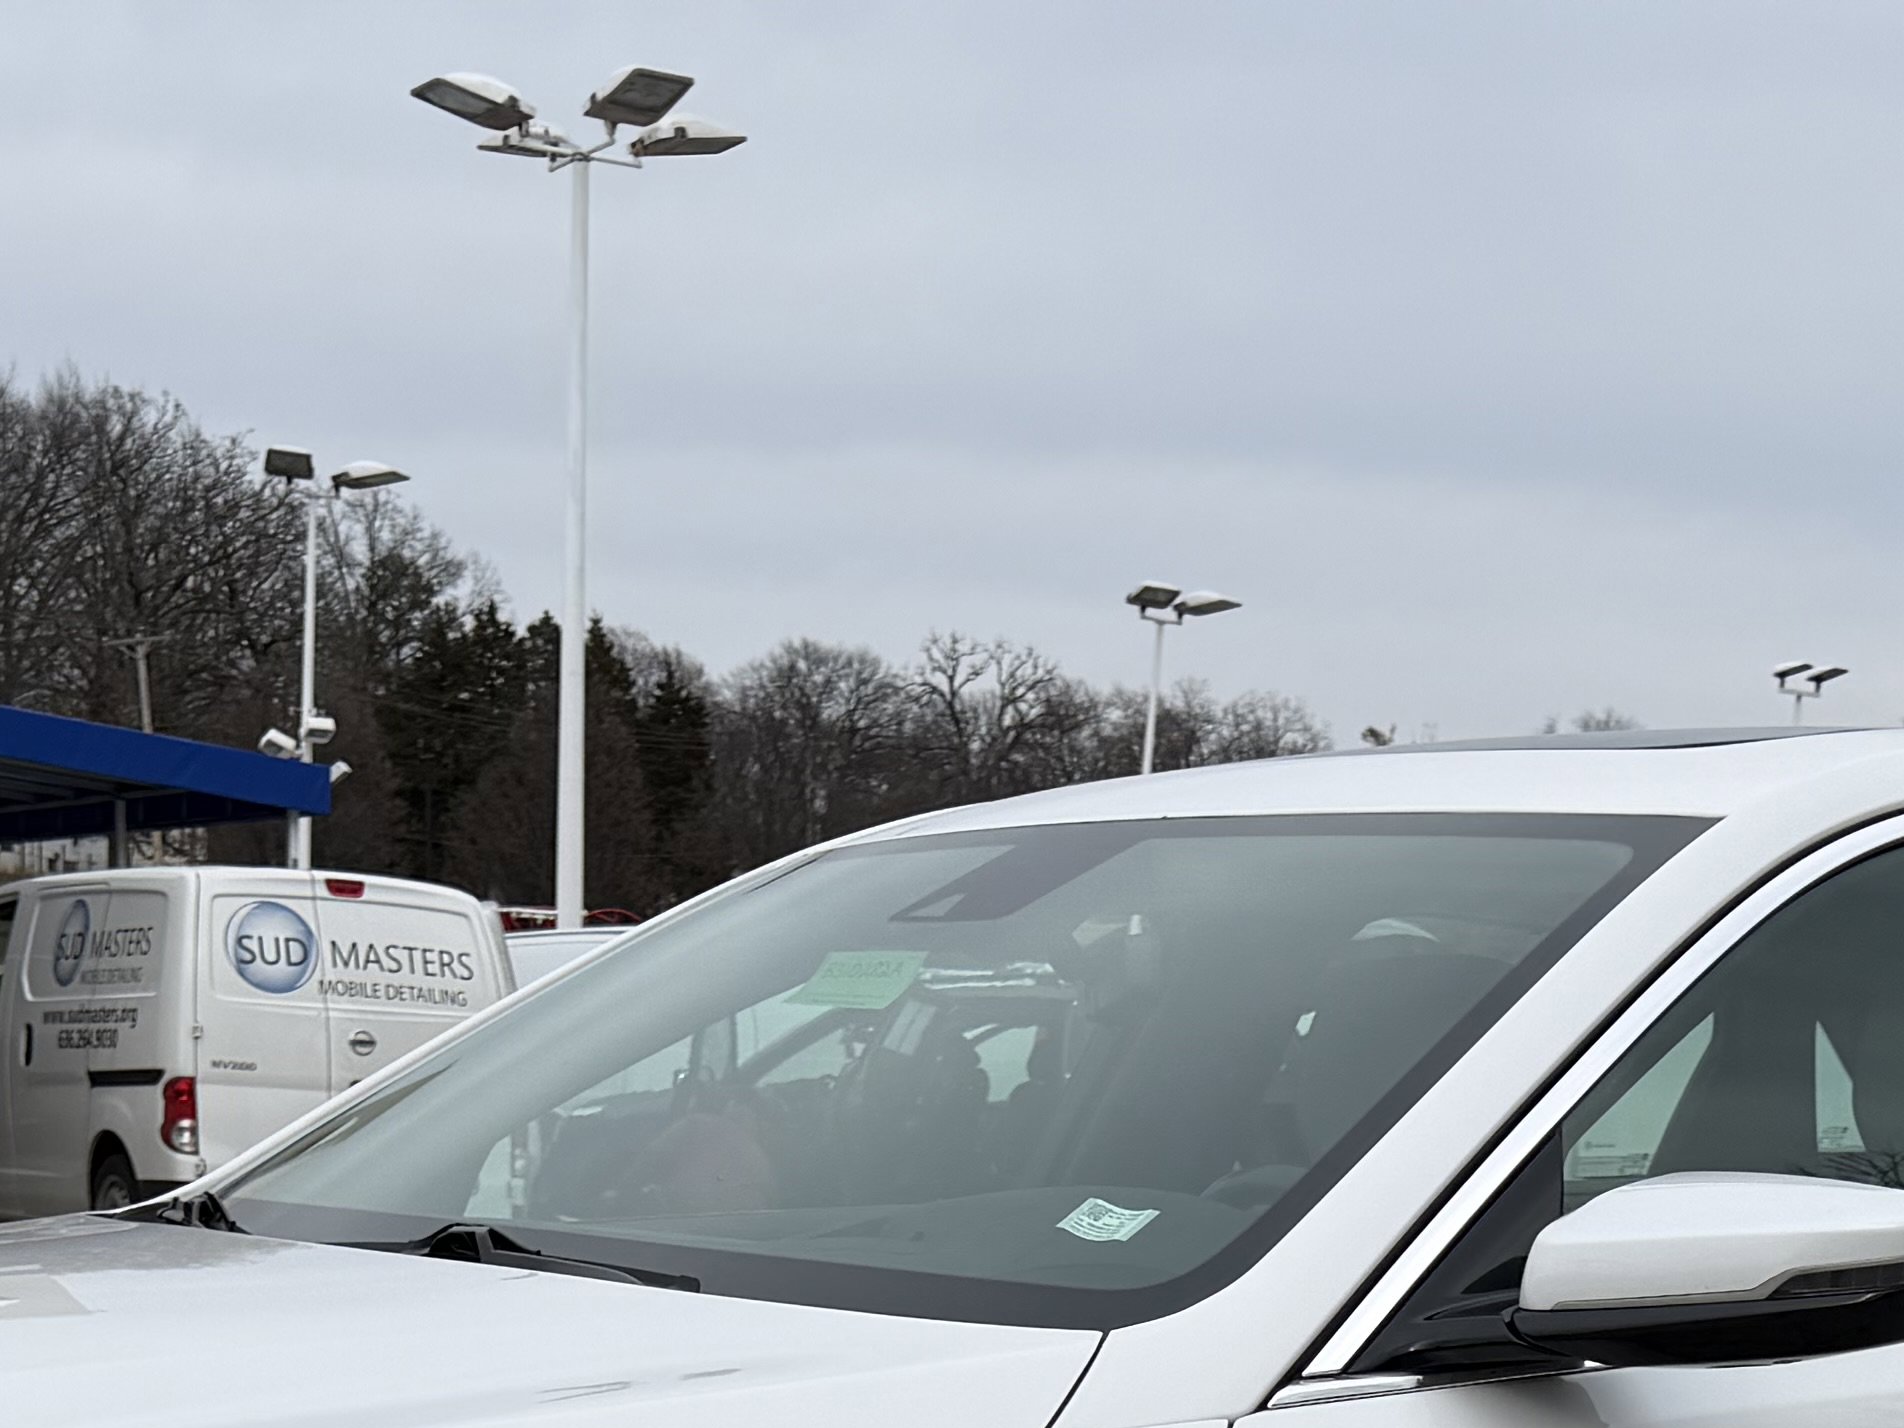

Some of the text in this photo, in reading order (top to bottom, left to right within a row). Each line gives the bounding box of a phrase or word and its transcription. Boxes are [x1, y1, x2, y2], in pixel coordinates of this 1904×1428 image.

[56, 926, 154, 960] SUD MASTERS
[236, 934, 475, 981] SUD MASTERS
[318, 979, 468, 1007] MOBILE DETAILING
